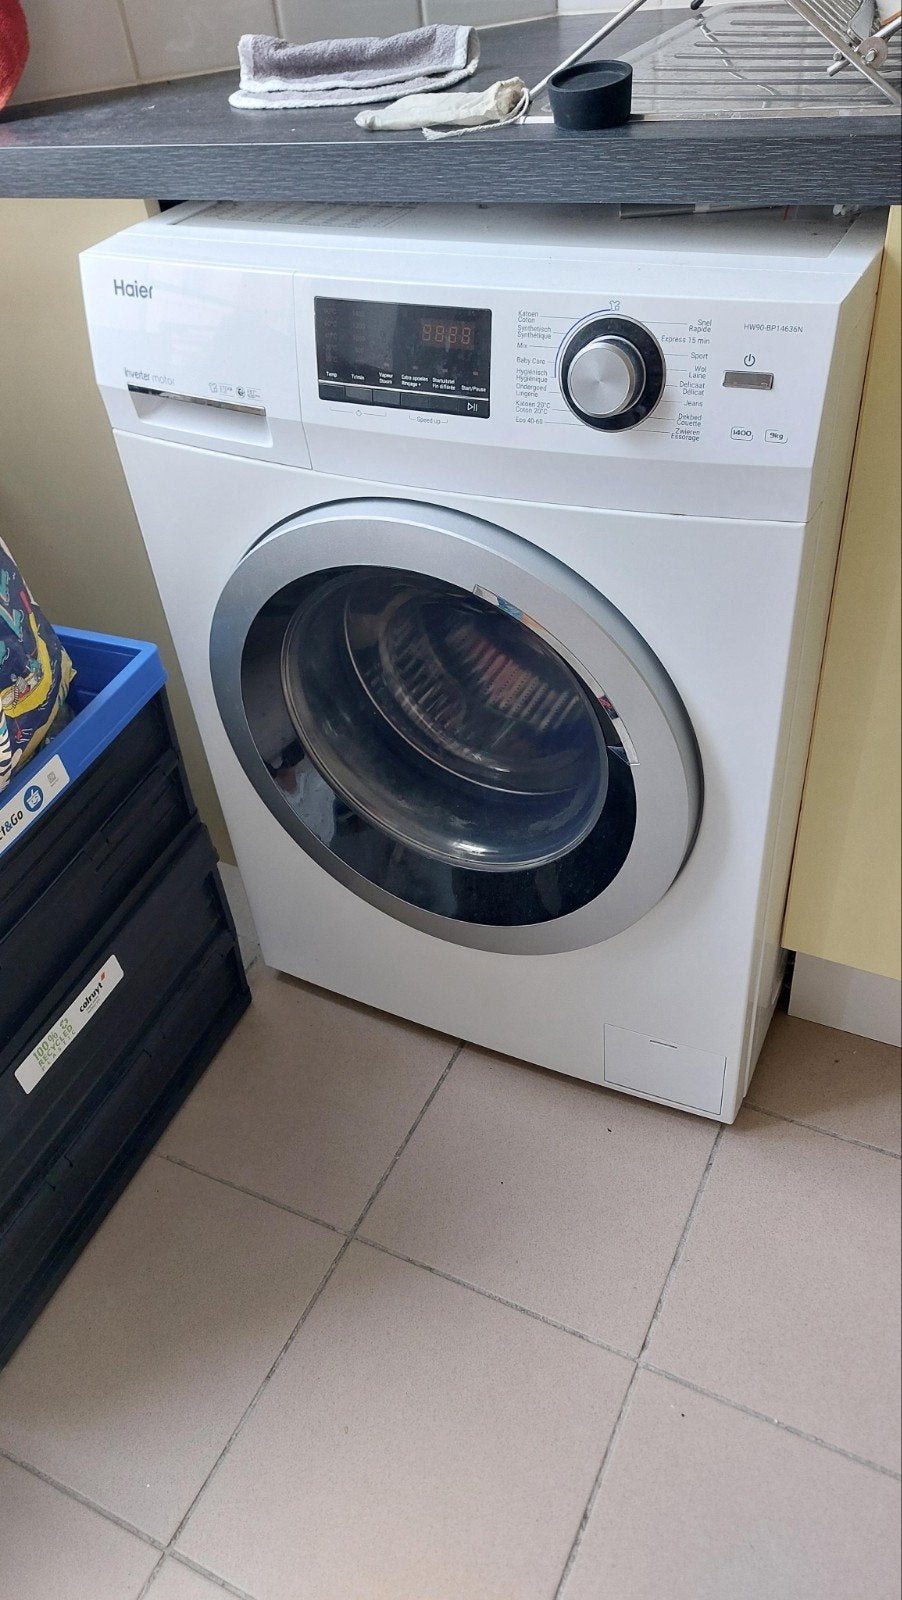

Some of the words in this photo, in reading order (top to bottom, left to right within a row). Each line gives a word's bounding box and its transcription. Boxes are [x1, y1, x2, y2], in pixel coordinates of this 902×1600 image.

[113, 279, 153, 299] Haier
[697, 319, 712, 327] Snel
[689, 325, 711, 333] Rapide
[661, 335, 686, 343] Express
[690, 352, 709, 360] Sport
[516, 356, 530, 366] Baby
[695, 365, 707, 373] Wol
[124, 367, 150, 381] Inverter
[152, 374, 175, 386] motor
[461, 384, 487, 393] Start/Pause
[671, 432, 700, 442] Essorage
[733, 429, 752, 437] 1400
[769, 432, 784, 441] 9kg
[79, 982, 103, 1013] colruyt
[38, 1024, 73, 1067] RECYCLED
